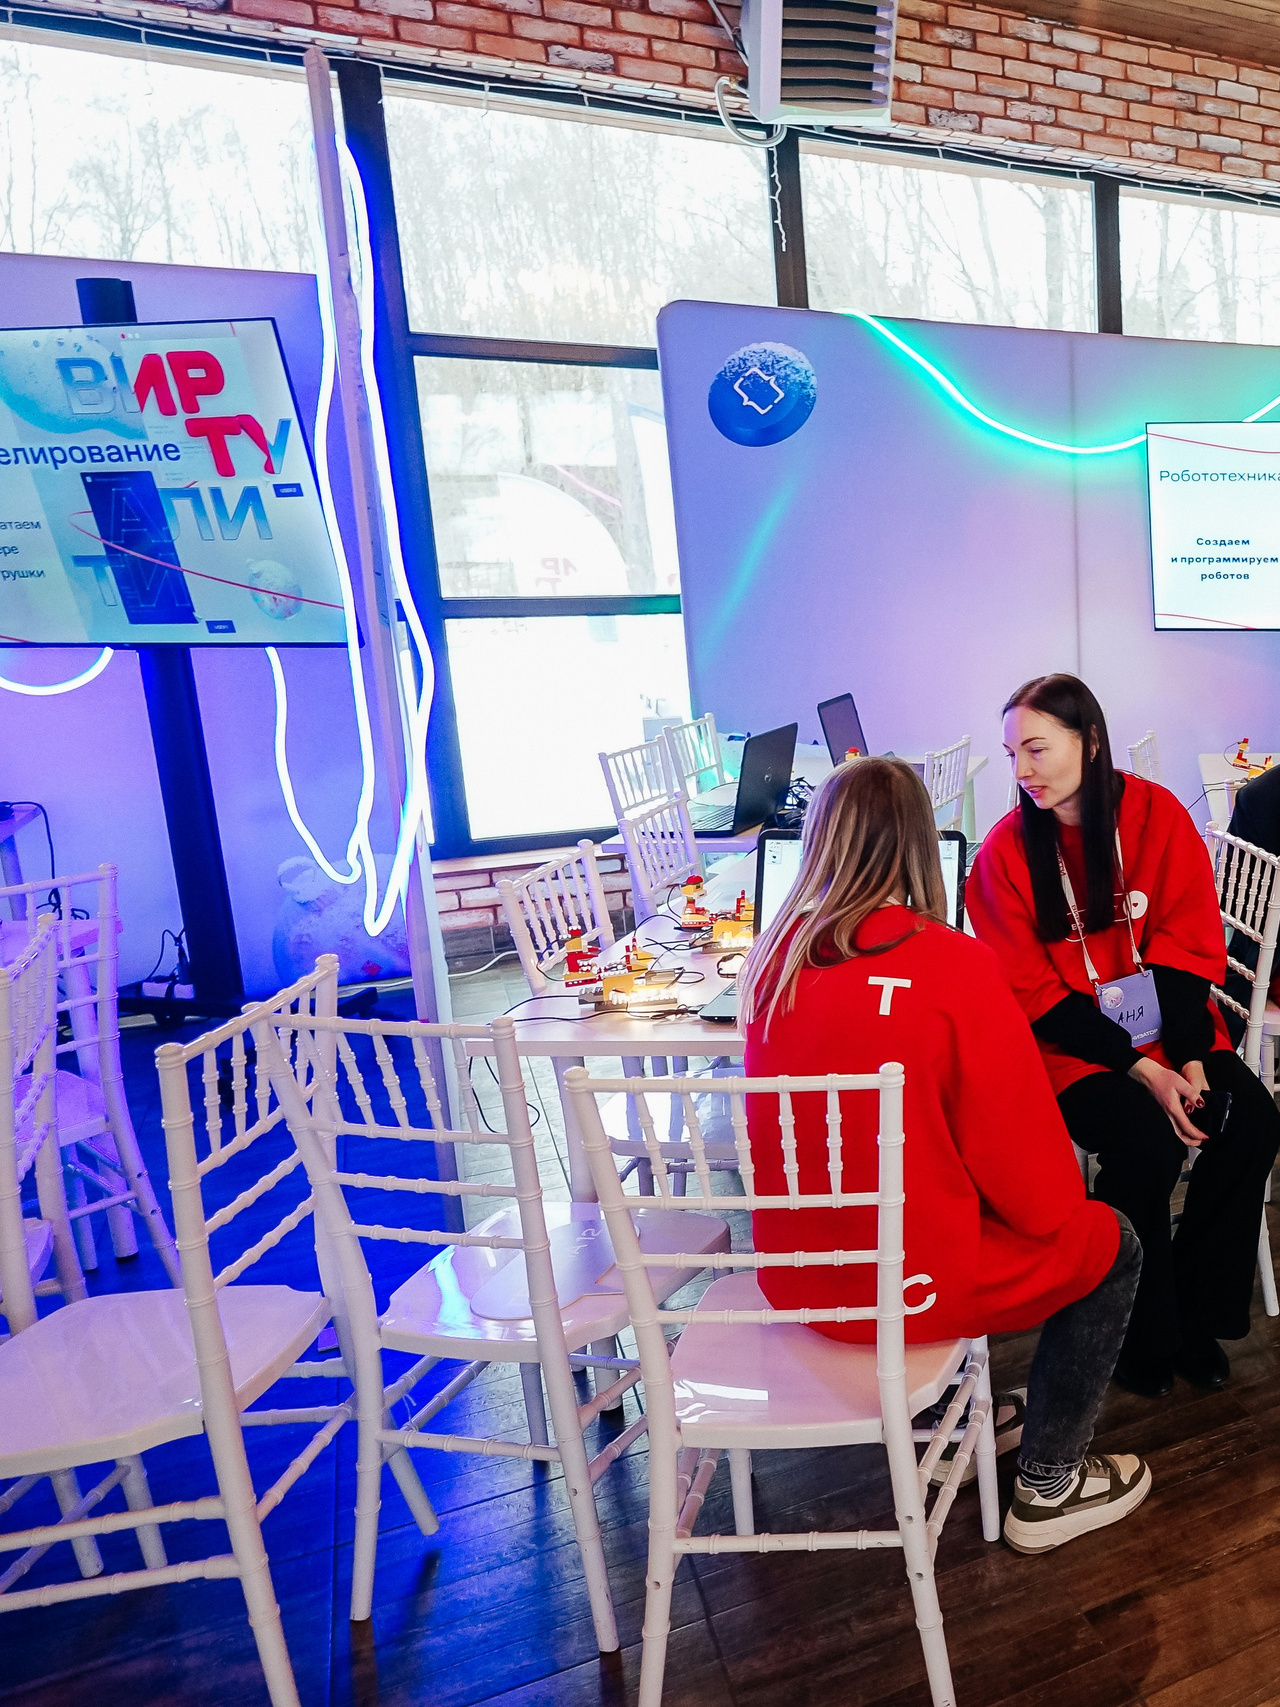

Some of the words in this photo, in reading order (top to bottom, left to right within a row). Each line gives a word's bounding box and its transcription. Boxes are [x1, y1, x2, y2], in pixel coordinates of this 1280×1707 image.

[56, 351, 225, 415] ВИР
[185, 414, 292, 478] ТУ
[1196, 537, 1251, 547] Создаем
[1180, 557, 1279, 565] программируем
[0, 569, 46, 581] рушки
[1200, 571, 1250, 581] роботов
[1117, 1005, 1144, 1025] АНЯ
